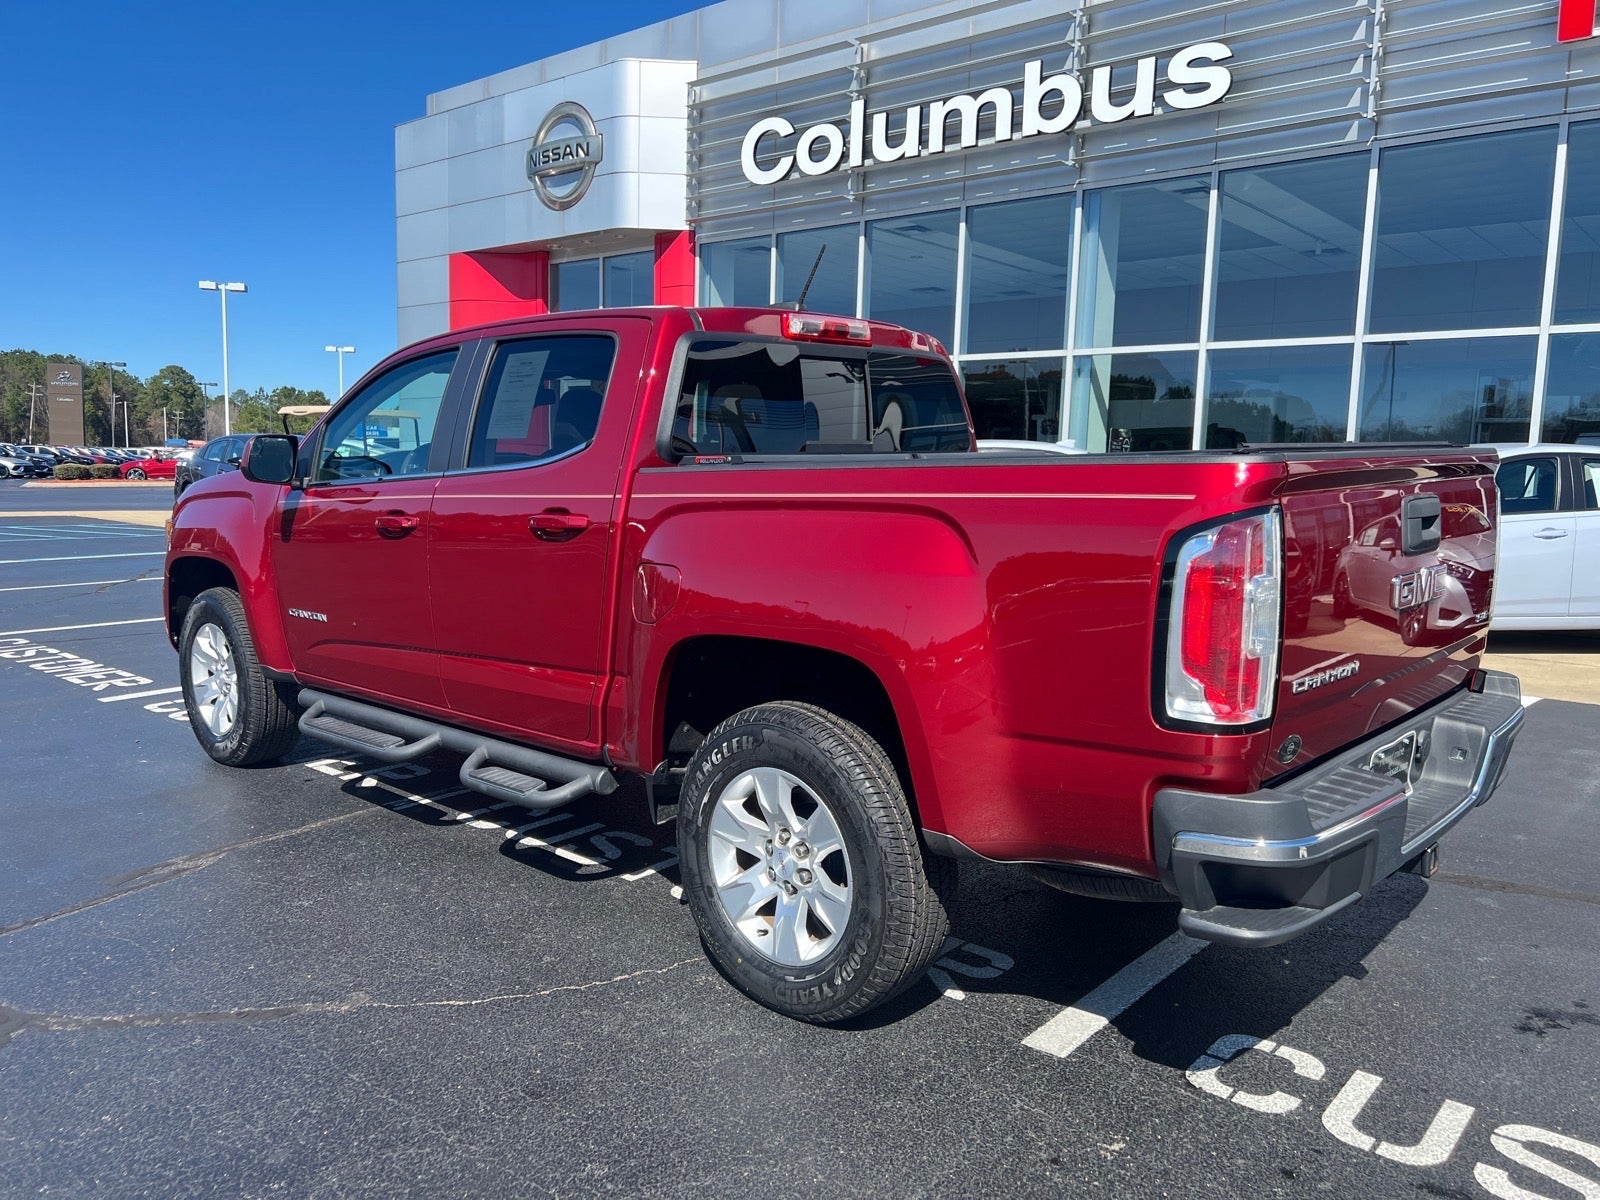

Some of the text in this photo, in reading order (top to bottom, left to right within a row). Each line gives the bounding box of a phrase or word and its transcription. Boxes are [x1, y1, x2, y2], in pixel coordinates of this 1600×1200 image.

[740, 42, 1233, 187] Columbus
[529, 141, 590, 169] NISSAN
[1391, 563, 1448, 610] GMC
[288, 607, 328, 623] CANYON
[1292, 660, 1360, 694] CANYON
[683, 734, 756, 818] WRANGLER
